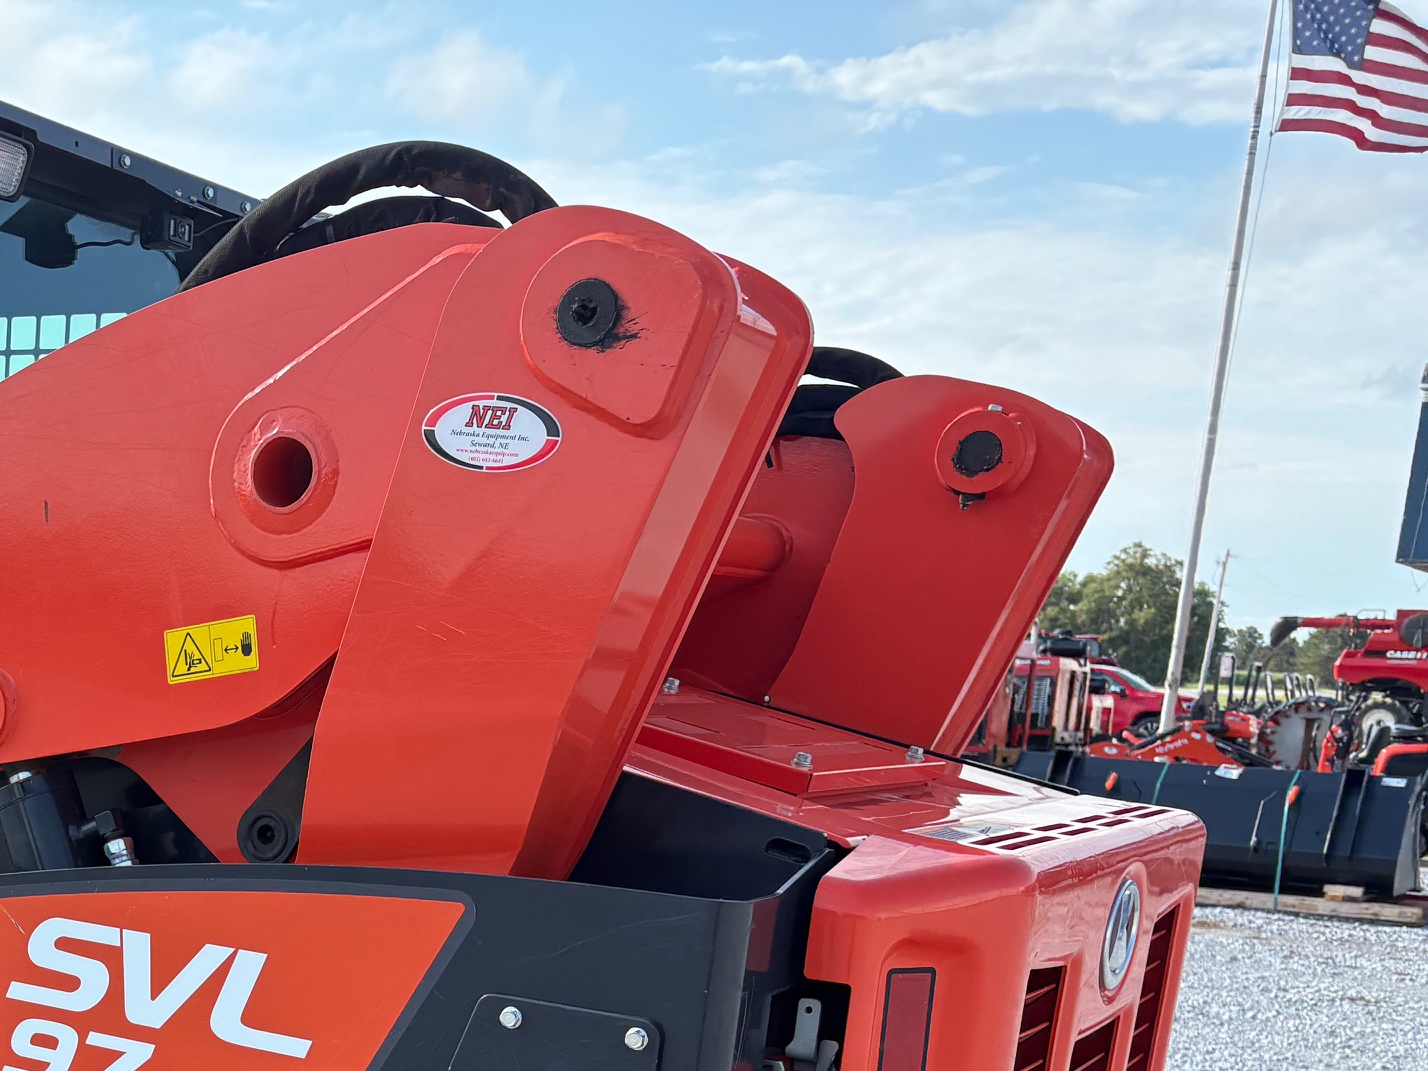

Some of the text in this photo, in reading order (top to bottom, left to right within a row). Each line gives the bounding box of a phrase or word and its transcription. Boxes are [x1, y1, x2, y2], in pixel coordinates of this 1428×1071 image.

[465, 404, 518, 430] NEI
[450, 429, 530, 442] Nebraska Equipment Inc.
[470, 440, 496, 449] Seward,
[6, 917, 313, 1059] SVL
